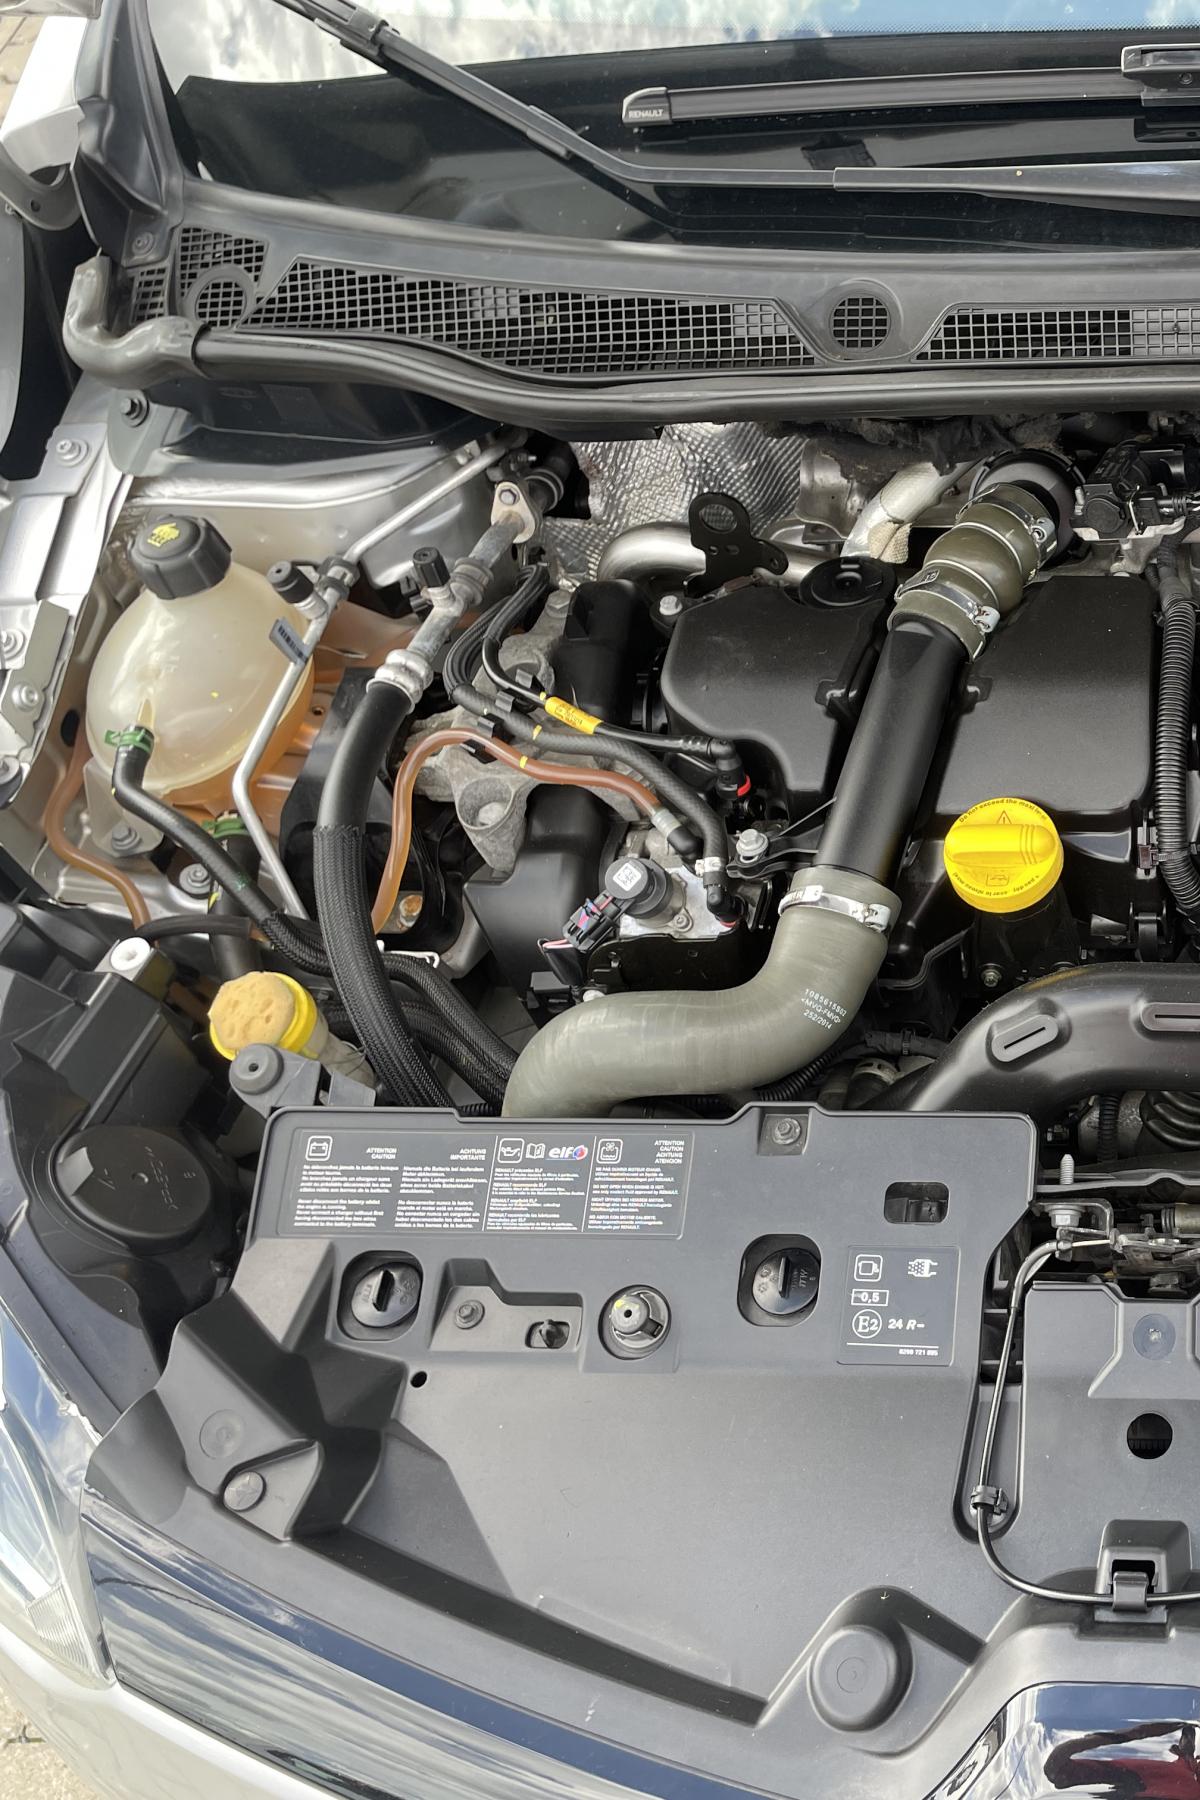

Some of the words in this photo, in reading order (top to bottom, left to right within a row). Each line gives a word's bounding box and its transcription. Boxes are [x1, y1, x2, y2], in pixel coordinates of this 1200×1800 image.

[549, 1147, 574, 1158] elf
[861, 1292, 879, 1303] 0,5
[858, 1315, 878, 1332] E2
[888, 1319, 903, 1329] 24
